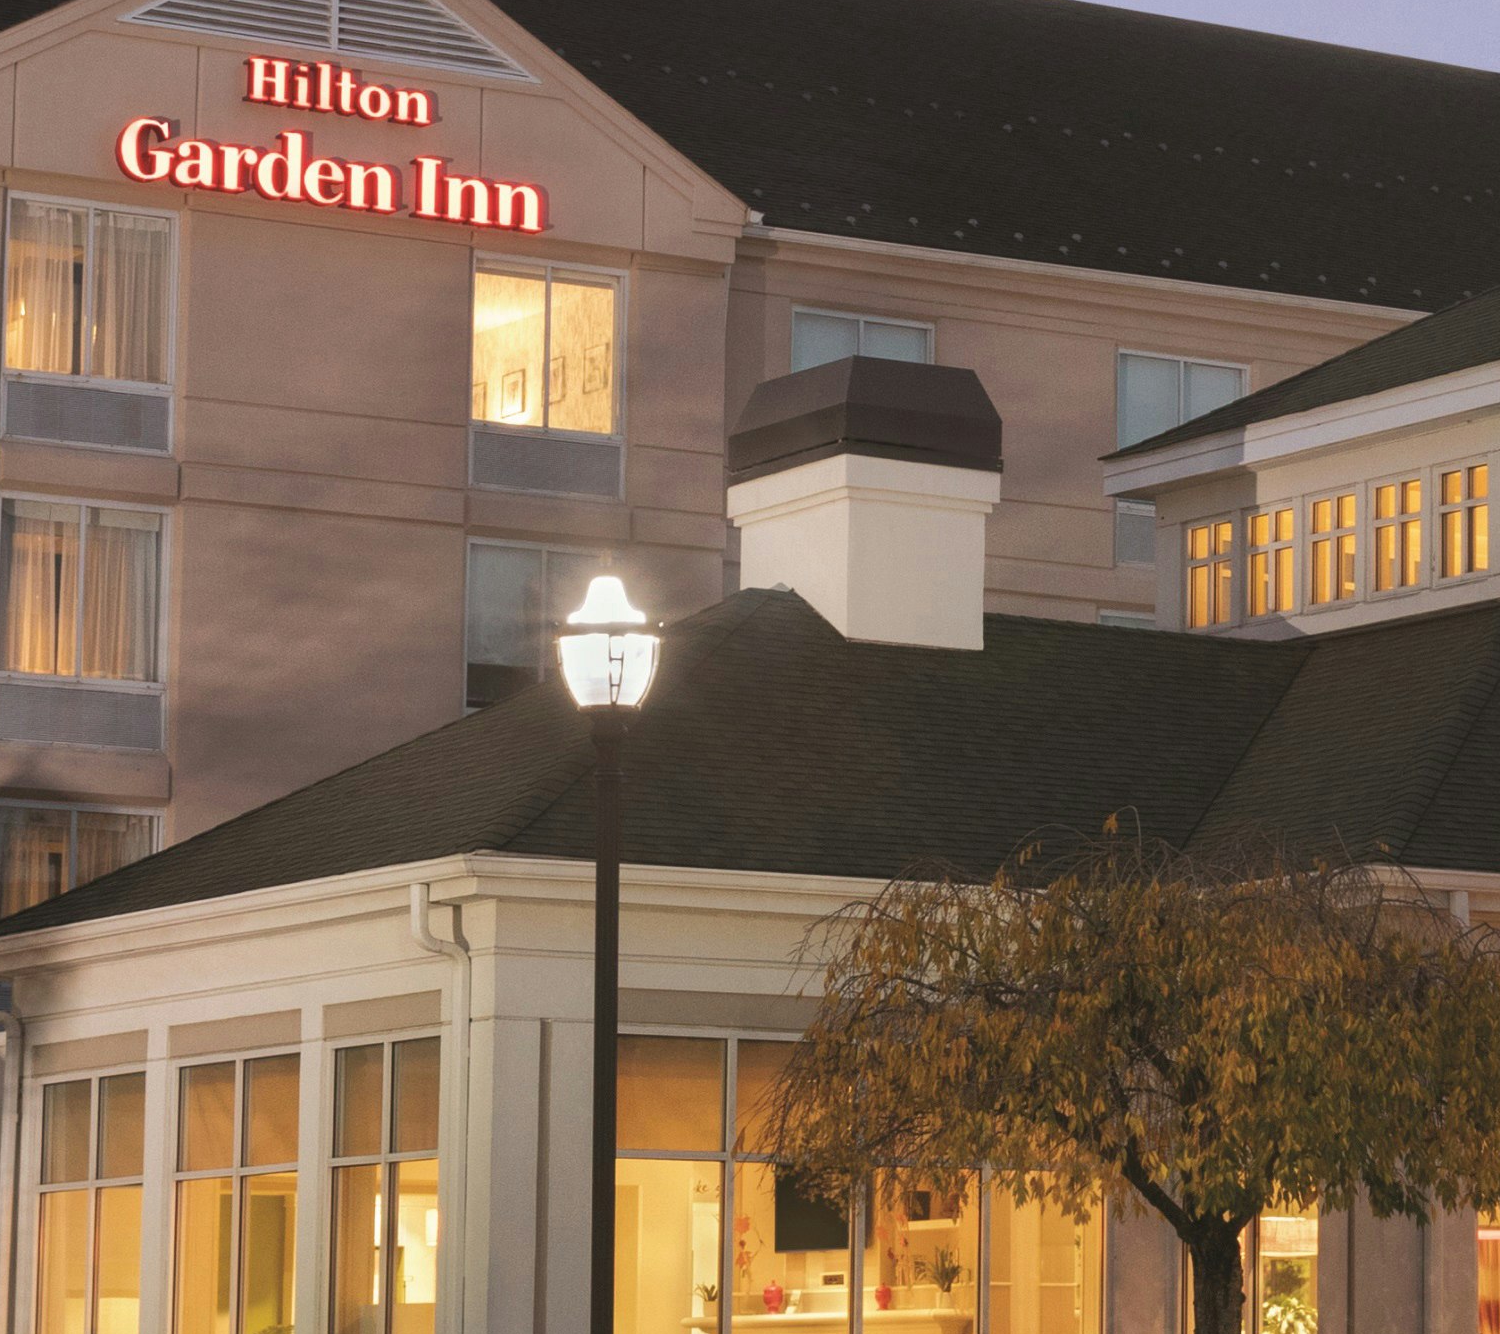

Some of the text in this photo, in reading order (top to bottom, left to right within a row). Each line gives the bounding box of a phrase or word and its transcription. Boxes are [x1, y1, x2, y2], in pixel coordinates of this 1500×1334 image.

[246, 55, 434, 126] Hilton
[117, 117, 545, 233] Garden Inn
